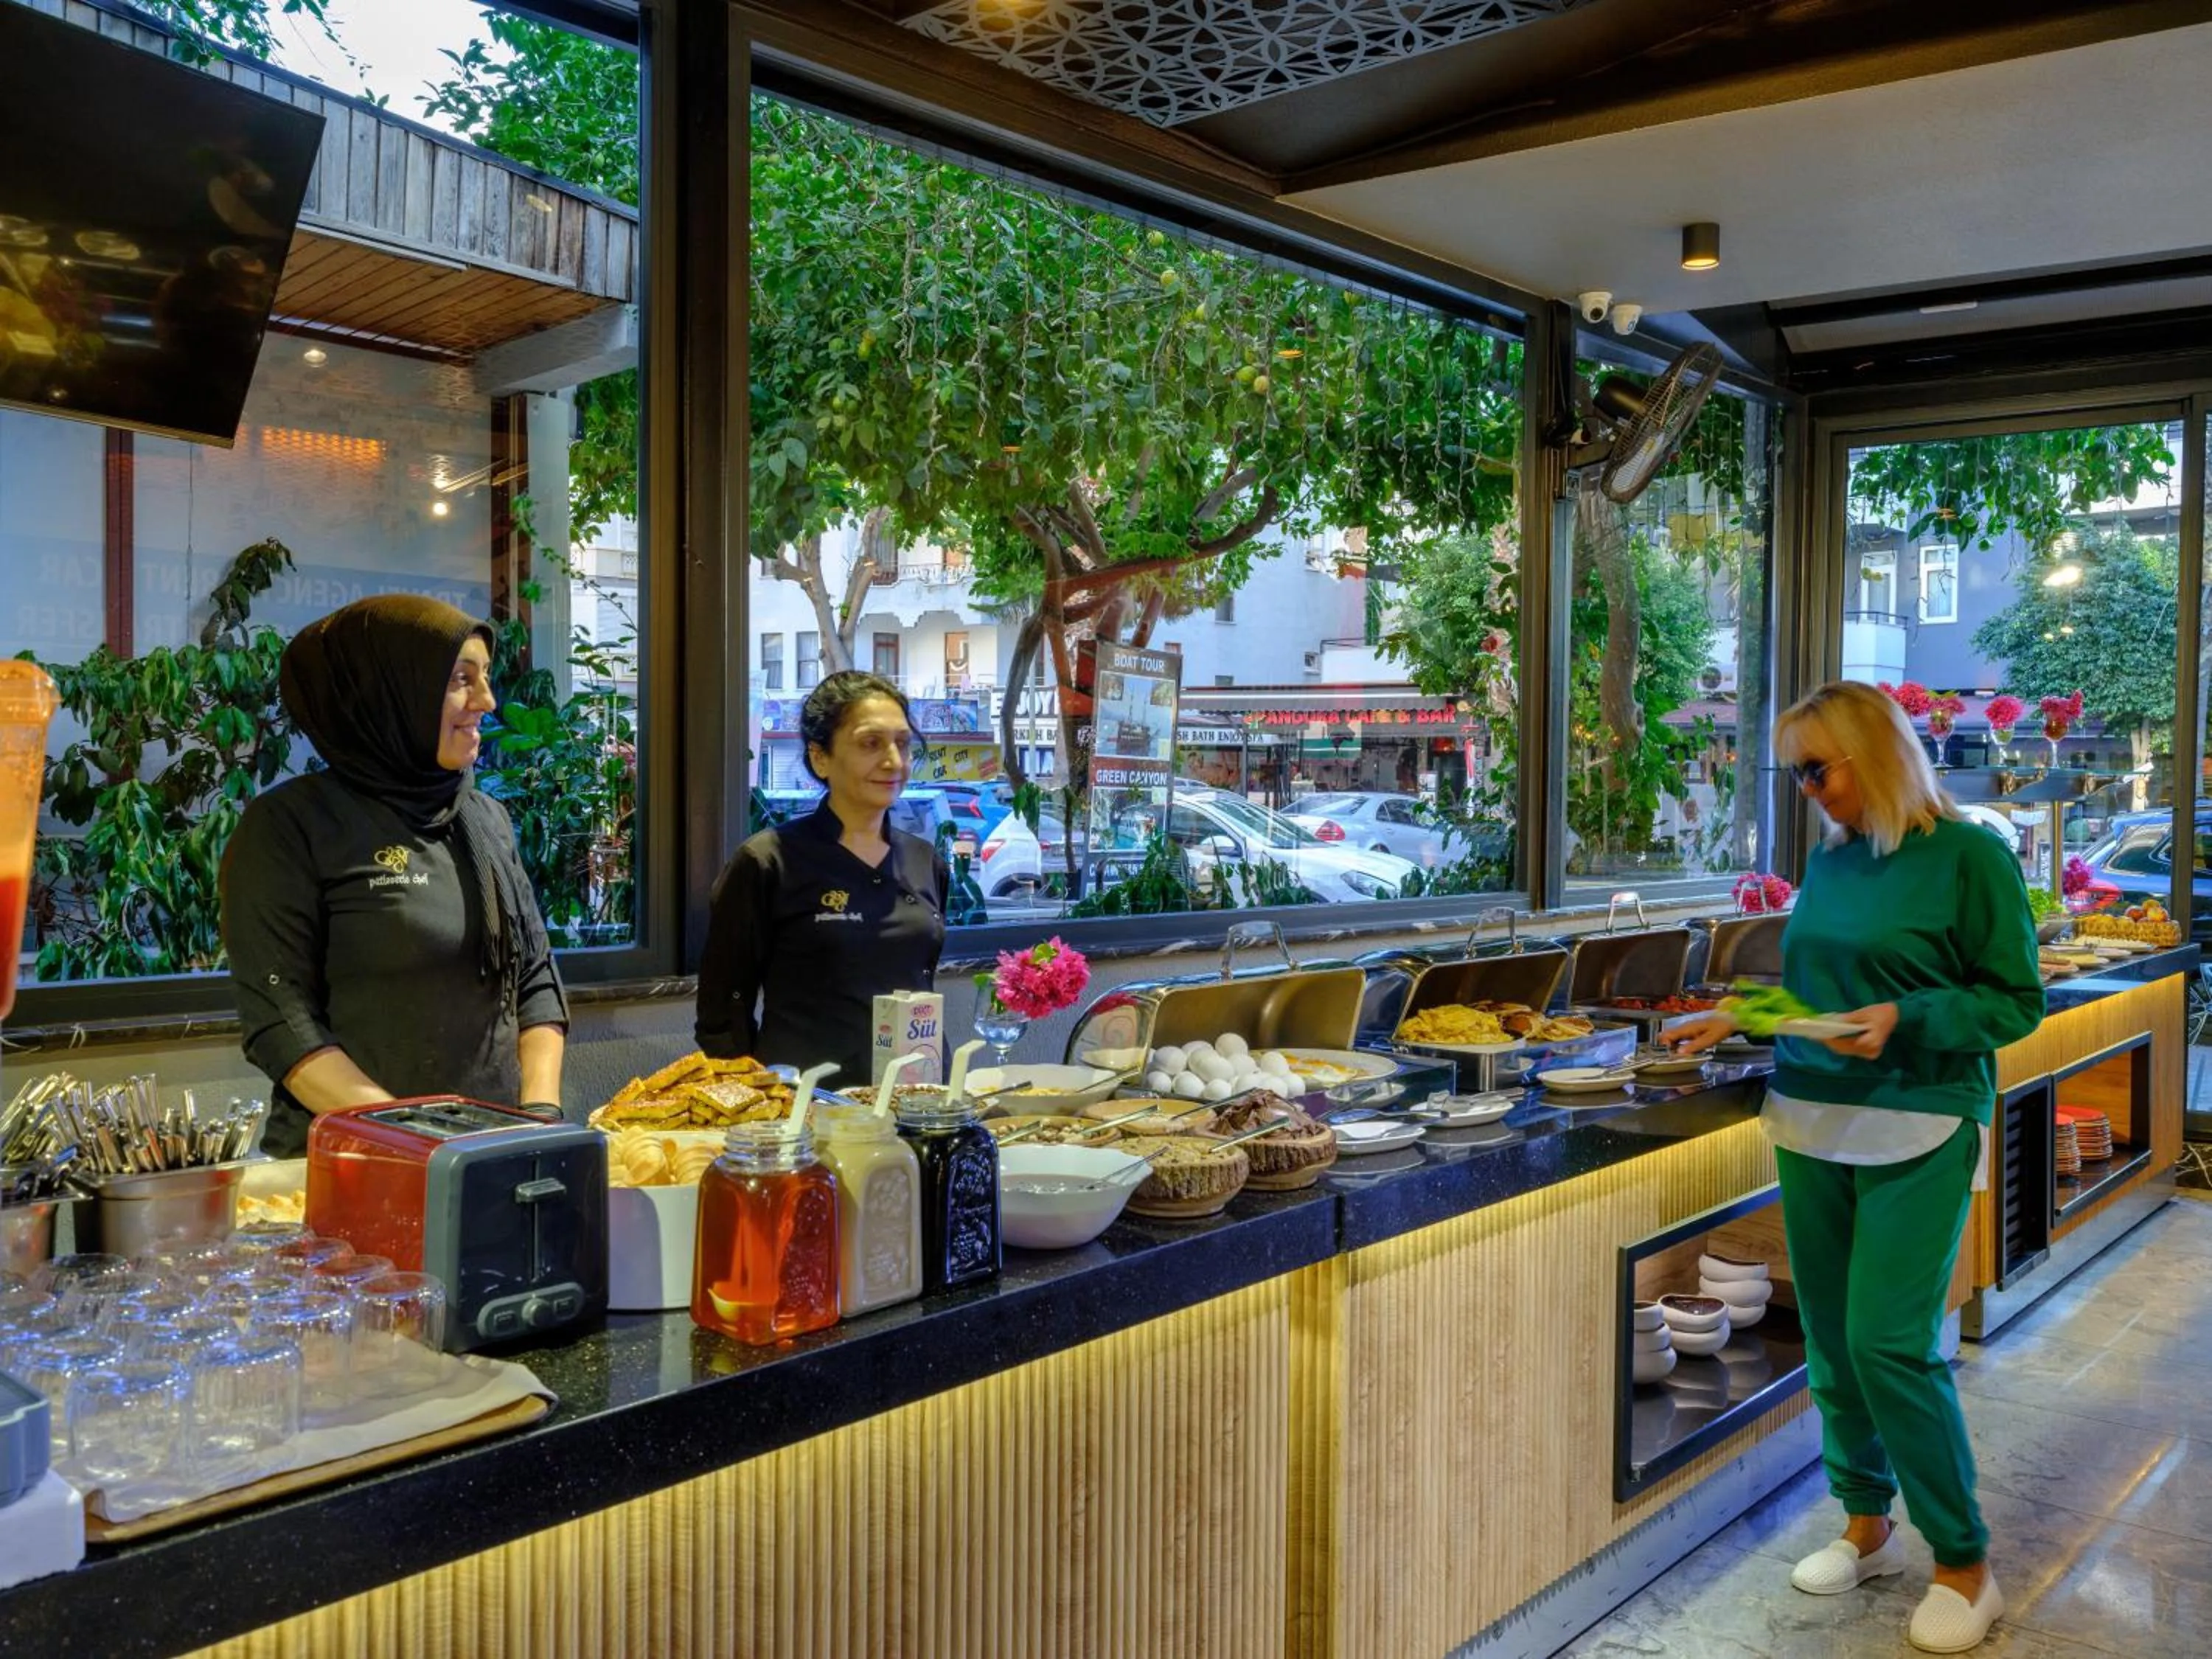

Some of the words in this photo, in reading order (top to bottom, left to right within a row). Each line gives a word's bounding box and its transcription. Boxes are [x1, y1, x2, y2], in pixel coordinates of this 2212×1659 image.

[1114, 652, 1138, 668] BOAT
[1141, 656, 1164, 673] TOUR
[990, 690, 1054, 716] EJOY
[1192, 730, 1215, 742] BATH
[1096, 769, 1127, 784] GREEN
[1129, 771, 1168, 786] CANYON
[907, 1018, 937, 1040] Süt
